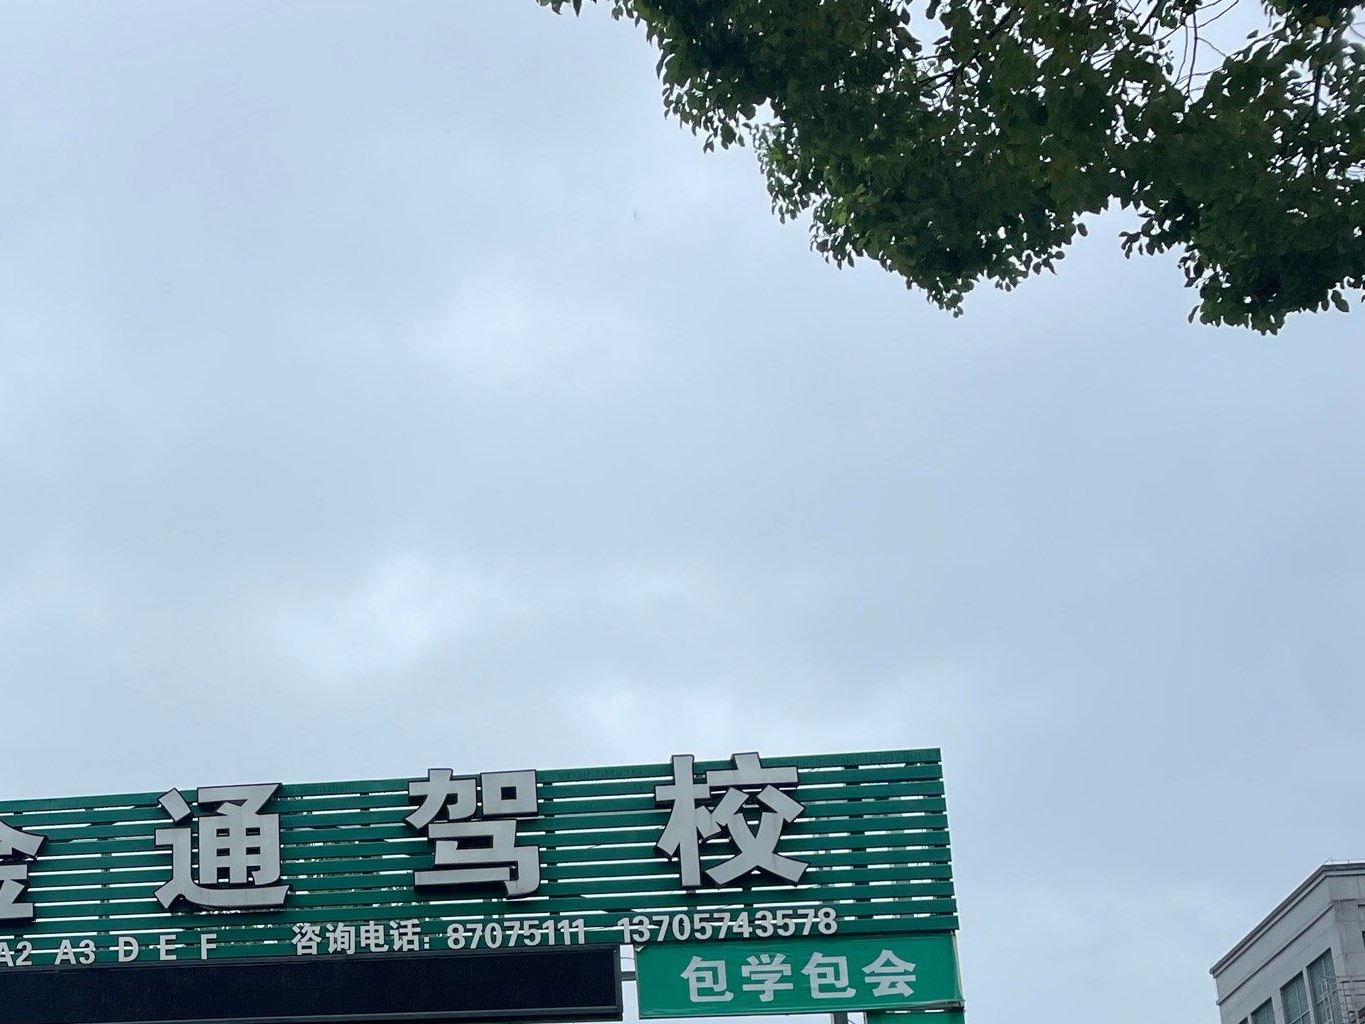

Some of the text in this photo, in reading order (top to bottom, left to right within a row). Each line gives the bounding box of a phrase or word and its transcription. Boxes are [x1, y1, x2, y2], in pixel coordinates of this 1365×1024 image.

[54, 939, 95, 964] A3
[119, 937, 139, 962] D
[159, 935, 177, 960] E
[201, 933, 218, 959] F
[446, 917, 586, 950] 87075111
[617, 907, 838, 946] 13705743578
[680, 949, 917, 1003] 包学包会
